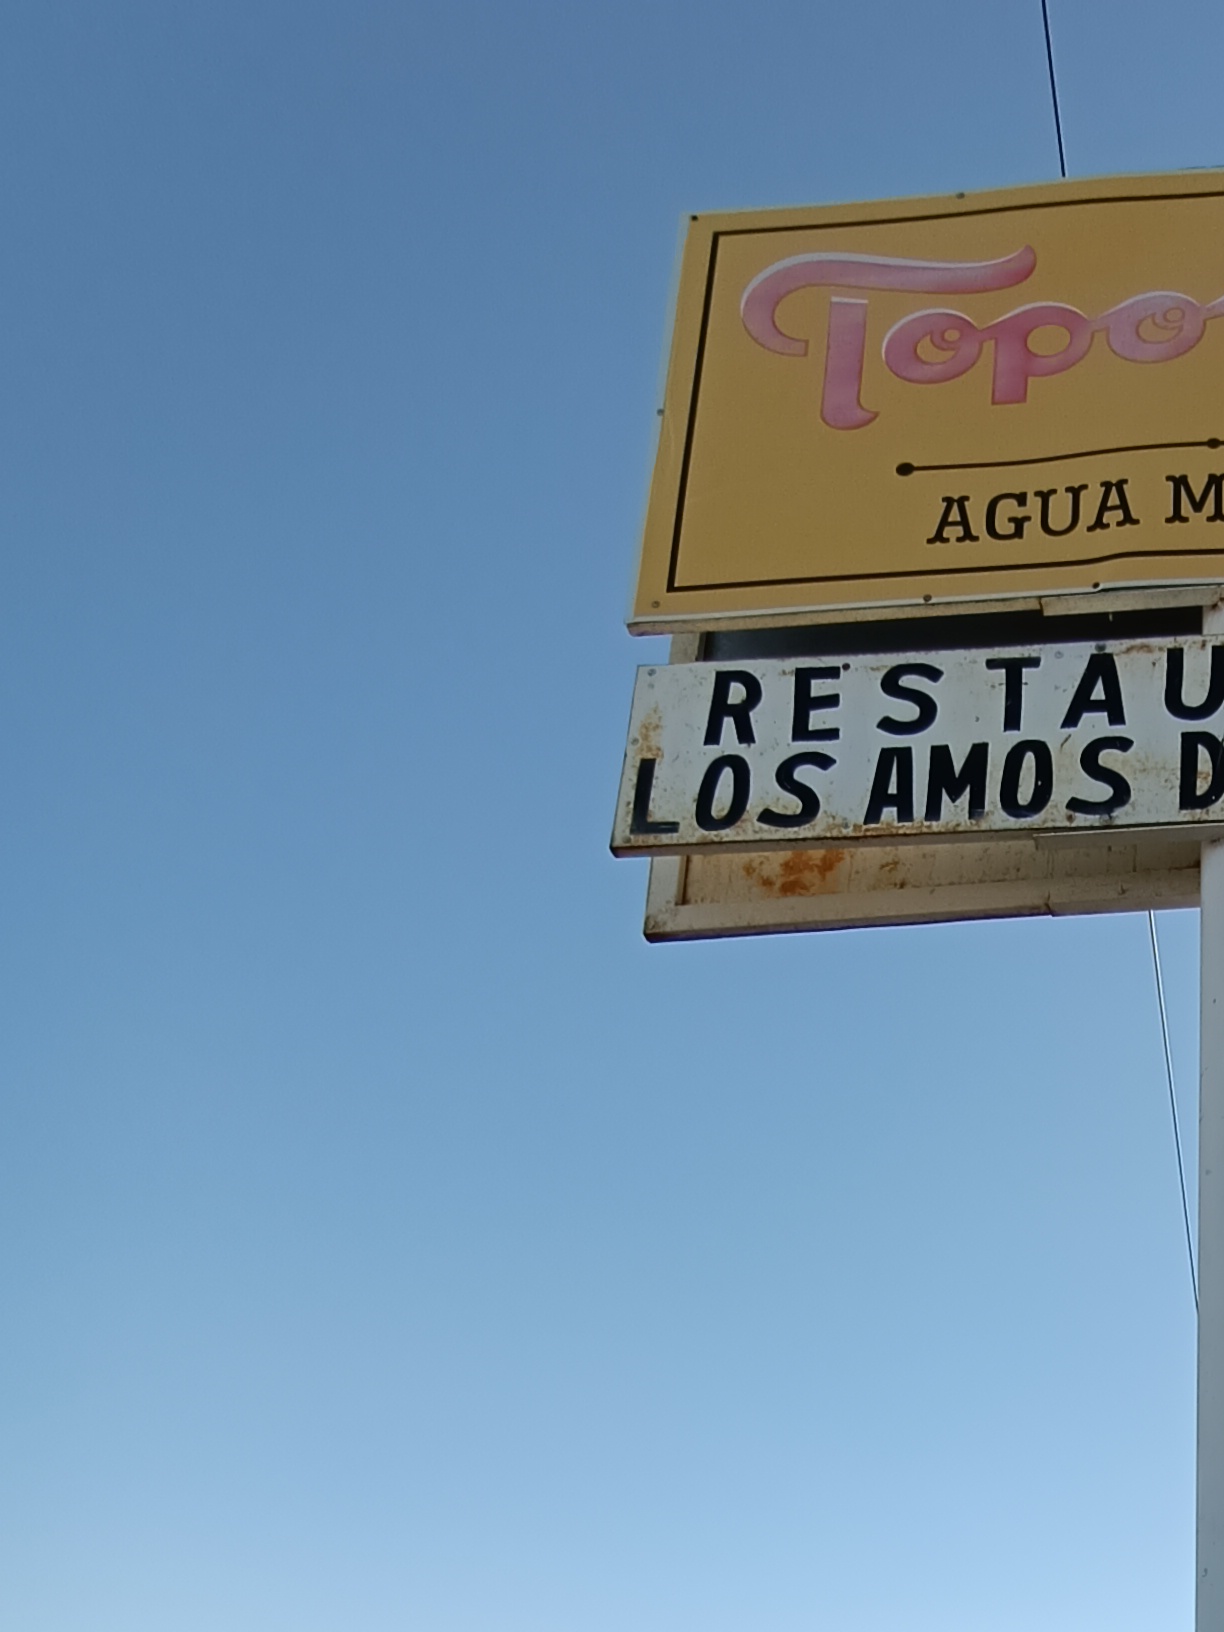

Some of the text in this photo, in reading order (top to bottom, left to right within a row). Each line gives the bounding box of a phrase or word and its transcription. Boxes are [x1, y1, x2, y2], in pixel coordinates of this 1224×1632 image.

[741, 243, 1212, 431] Topo
[926, 479, 1141, 545] AGUA
[630, 751, 837, 834] LOS
[864, 736, 1134, 825] AMOS
